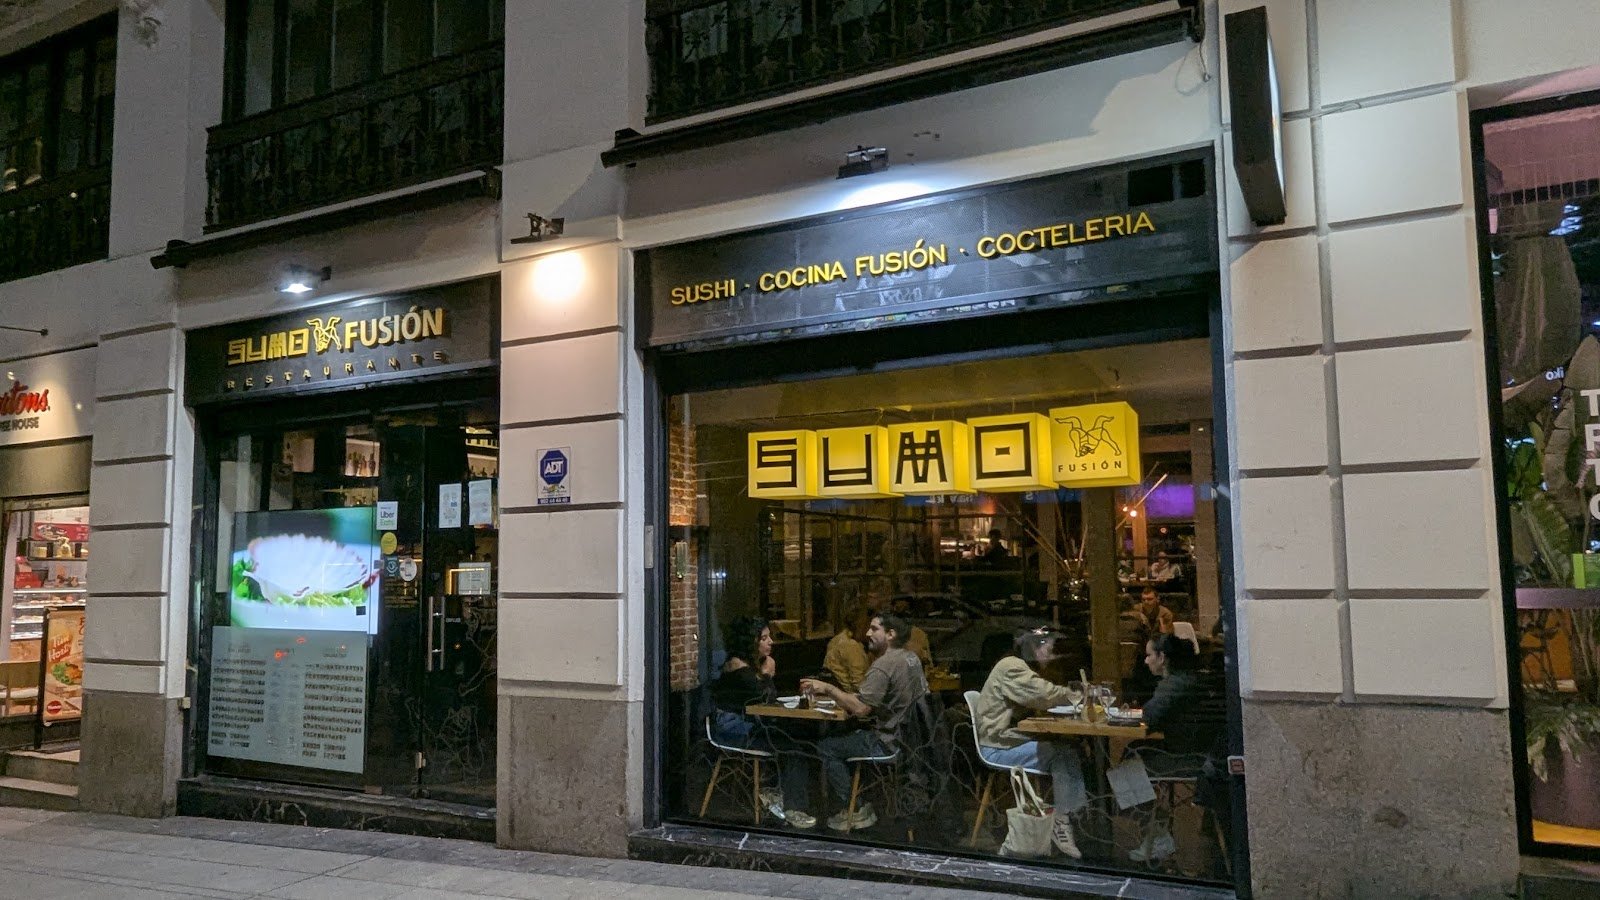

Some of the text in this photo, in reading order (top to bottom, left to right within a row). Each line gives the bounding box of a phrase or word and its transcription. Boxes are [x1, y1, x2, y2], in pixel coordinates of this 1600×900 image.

[671, 212, 1155, 305] SUSHI COCINA FUSIÓN COCTELERIA
[227, 305, 444, 366] SUMO FUSIÓN
[227, 351, 443, 389] RESTAURANTE
[12, 417, 39, 430] HOUSE
[544, 460, 564, 474] ADT
[756, 421, 1031, 488] SUMO
[1058, 458, 1123, 473] FUSIÓN
[380, 511, 395, 519] Uber
